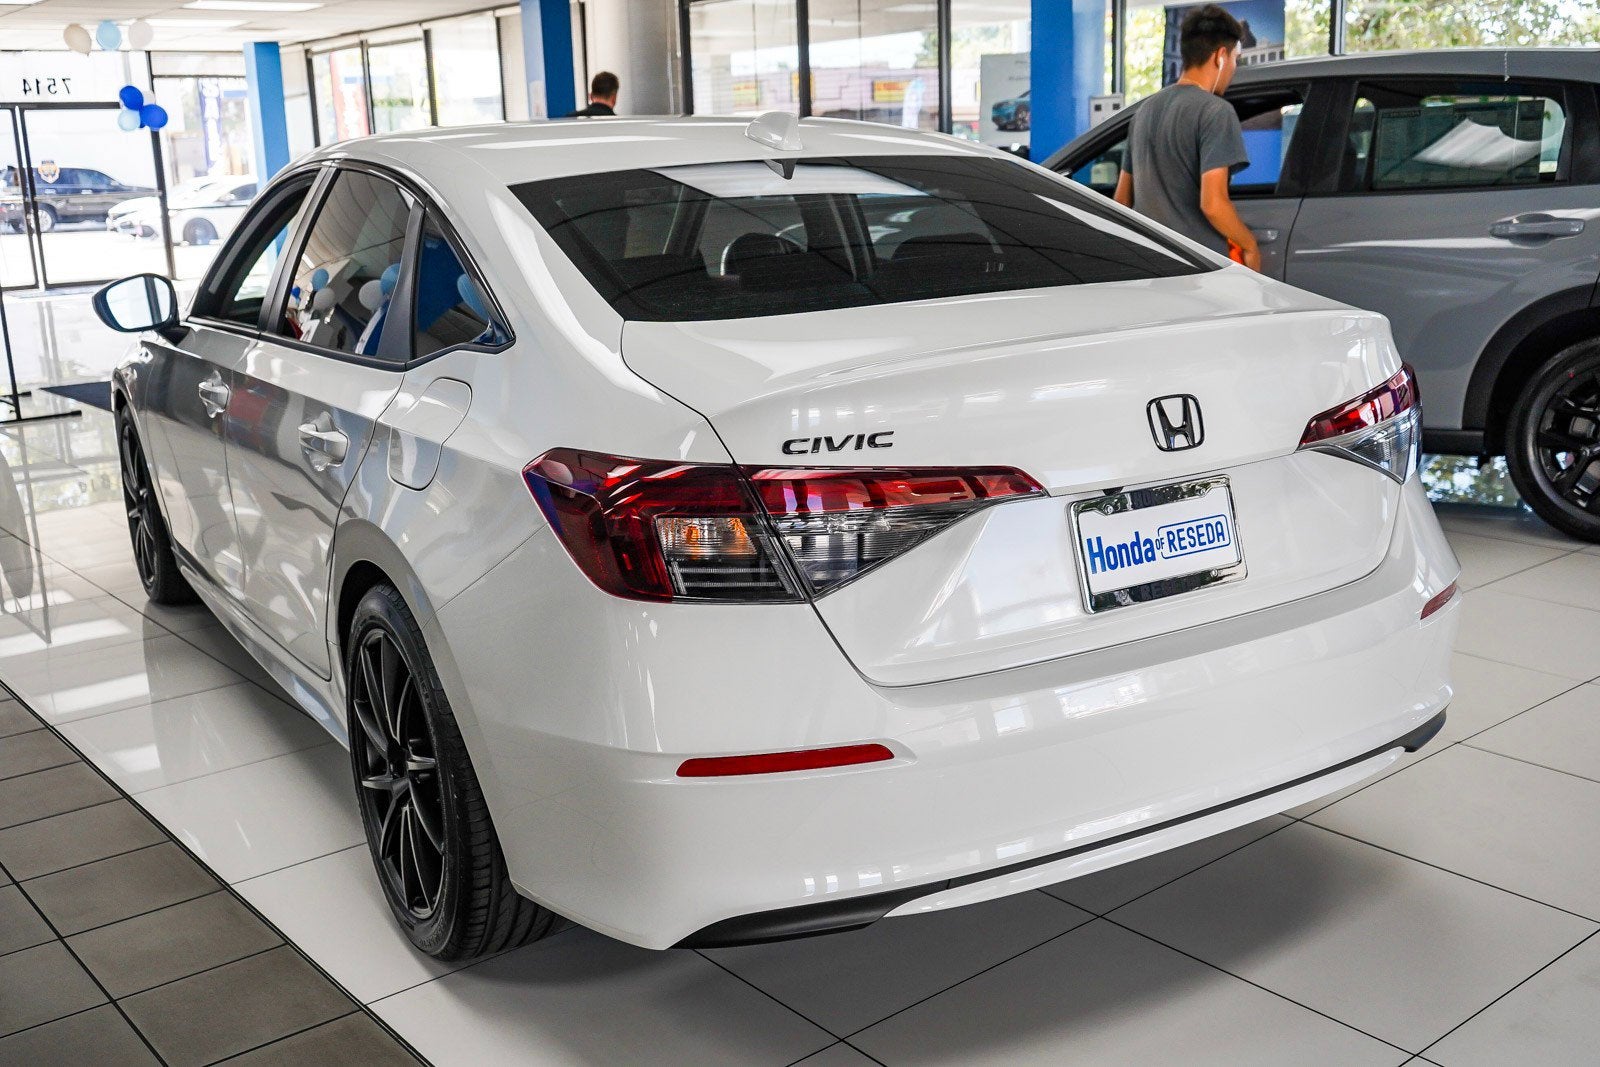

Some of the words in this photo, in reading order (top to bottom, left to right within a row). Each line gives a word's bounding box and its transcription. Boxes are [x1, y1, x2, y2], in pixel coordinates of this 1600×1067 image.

[781, 430, 895, 455] CIVIC
[1086, 531, 1157, 575] Honda
[1155, 537, 1165, 551] OF
[1166, 520, 1226, 553] RESEDA
